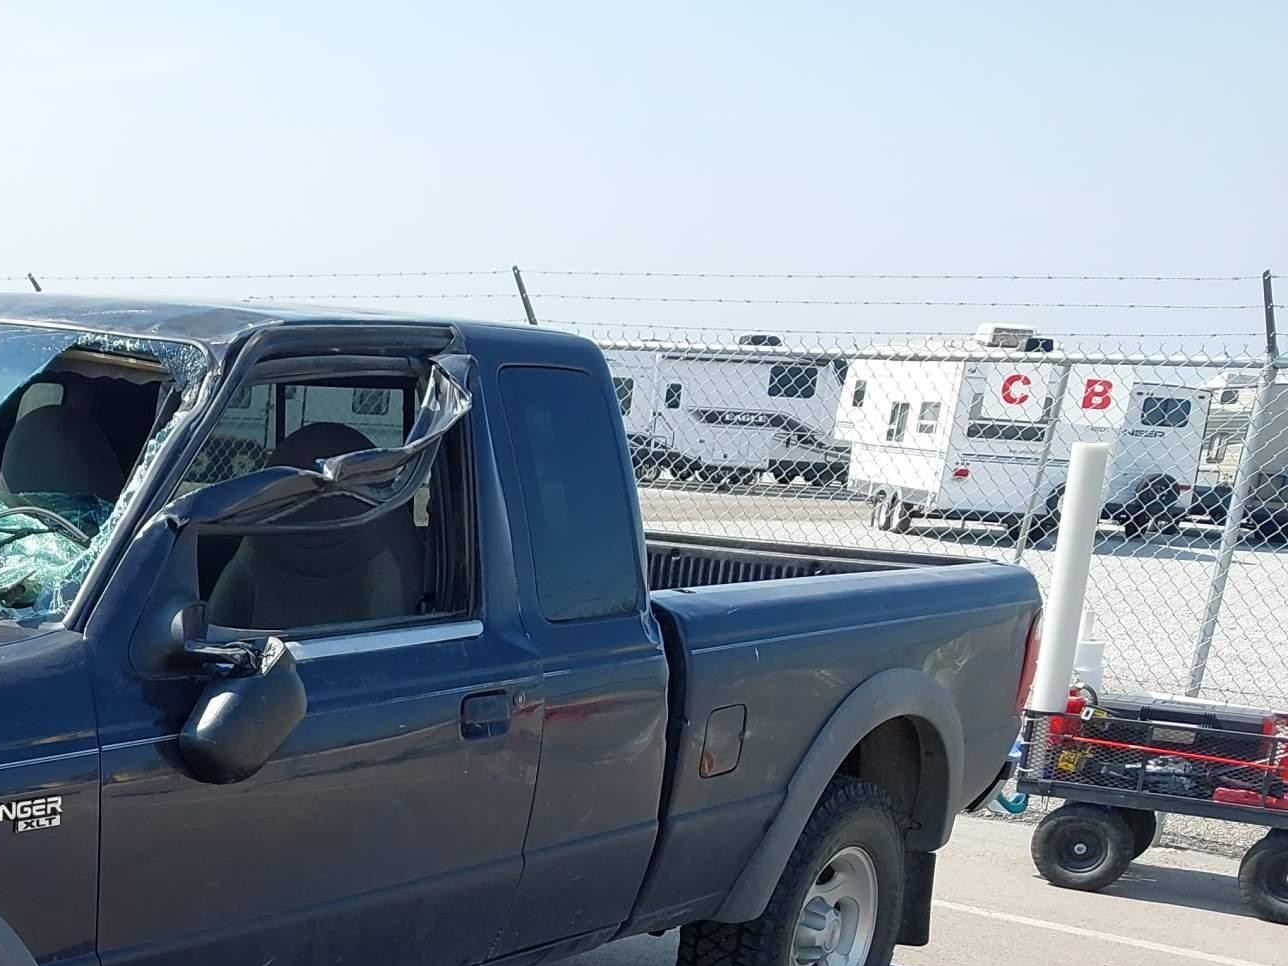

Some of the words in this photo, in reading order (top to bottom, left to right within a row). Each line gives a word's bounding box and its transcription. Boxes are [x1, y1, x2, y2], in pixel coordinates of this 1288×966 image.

[1001, 373, 1032, 405] C
[1081, 378, 1114, 410] B
[724, 412, 769, 423] EAGLE
[21, 815, 58, 831] XLT
